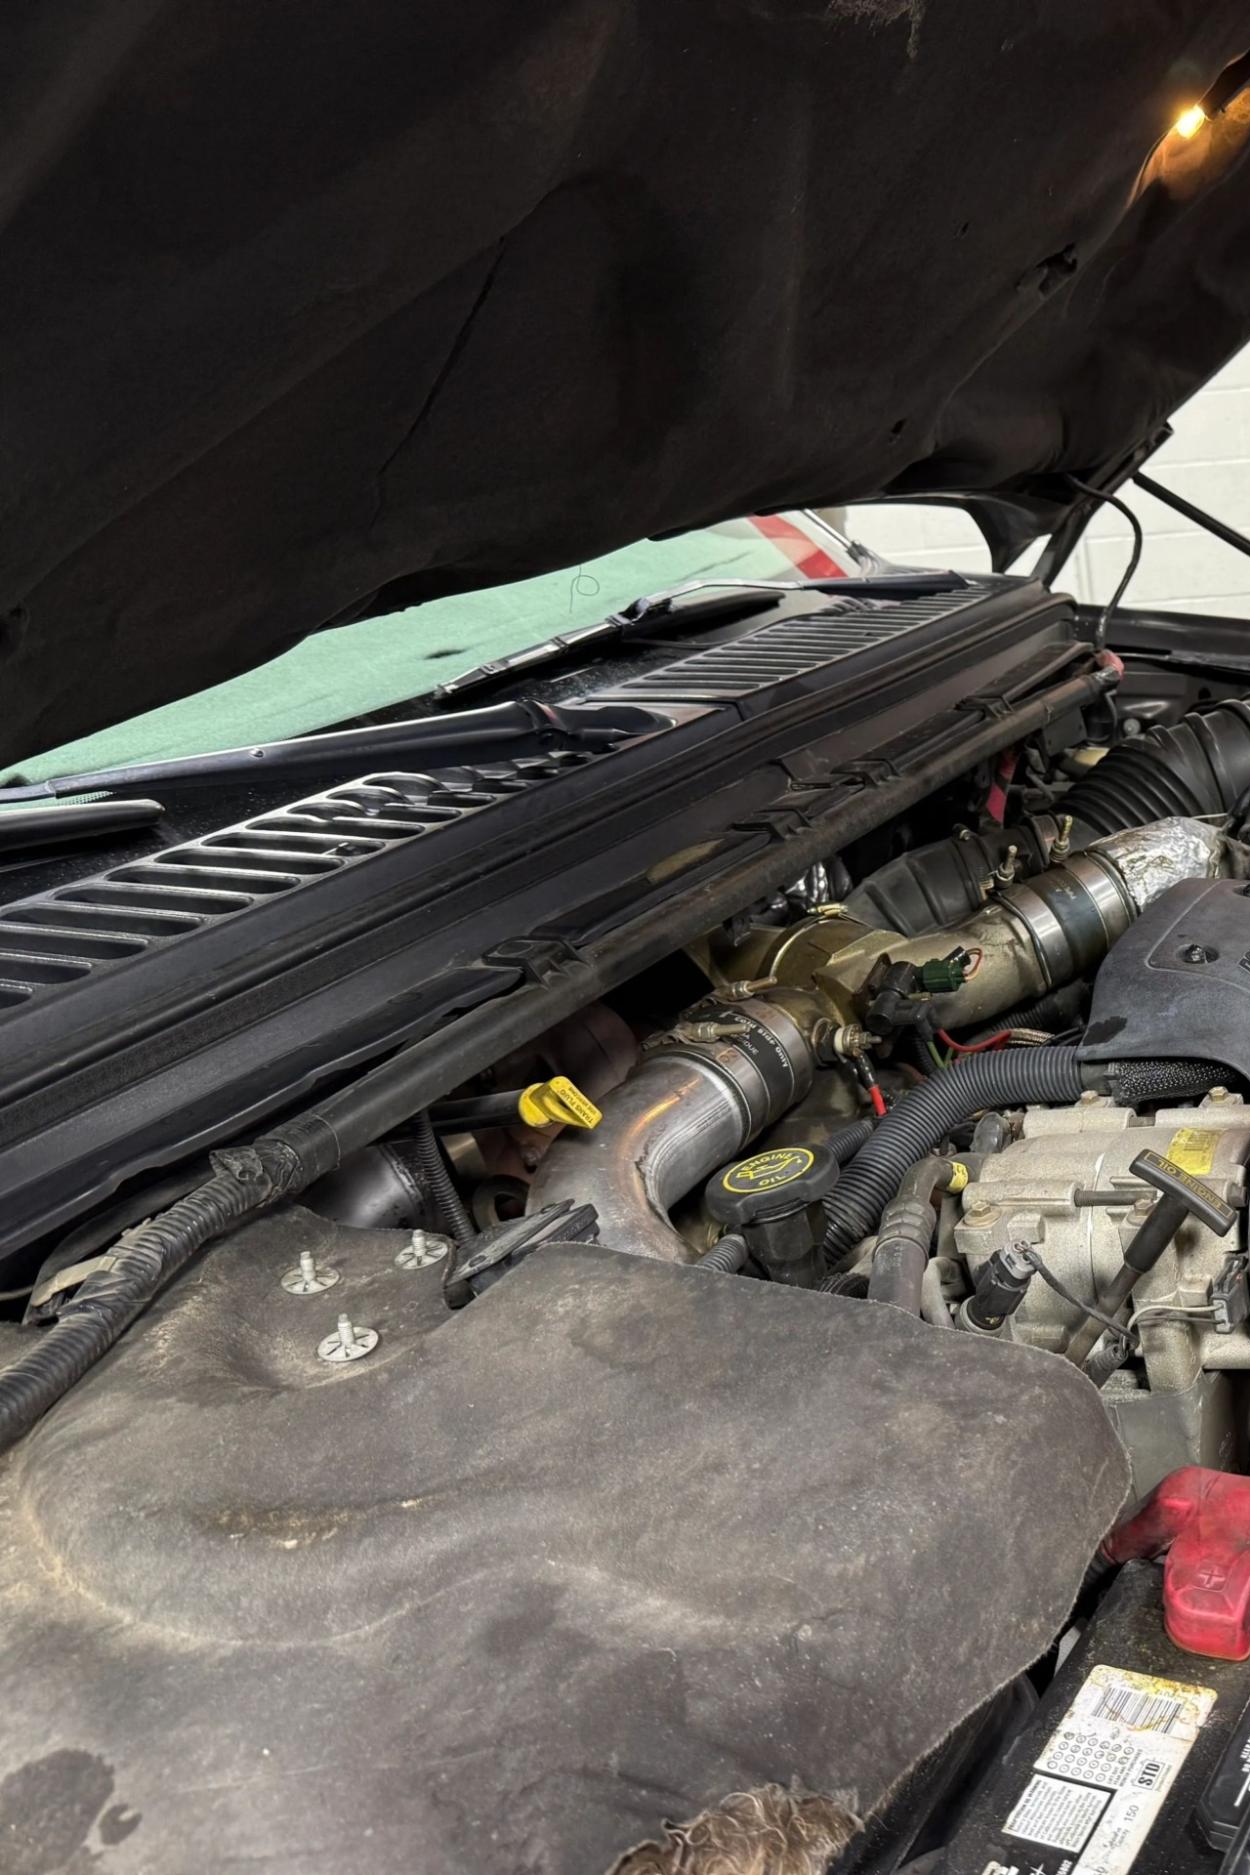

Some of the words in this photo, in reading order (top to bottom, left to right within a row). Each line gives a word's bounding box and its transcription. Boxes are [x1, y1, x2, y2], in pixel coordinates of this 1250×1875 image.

[741, 1152, 792, 1172] ENGINE
[1157, 1158, 1178, 1175] OIL
[759, 1174, 786, 1187] OIL
[1180, 1172, 1222, 1210] ENGINE
[1138, 1762, 1161, 1787] STD
[1123, 1804, 1140, 1822] 150
